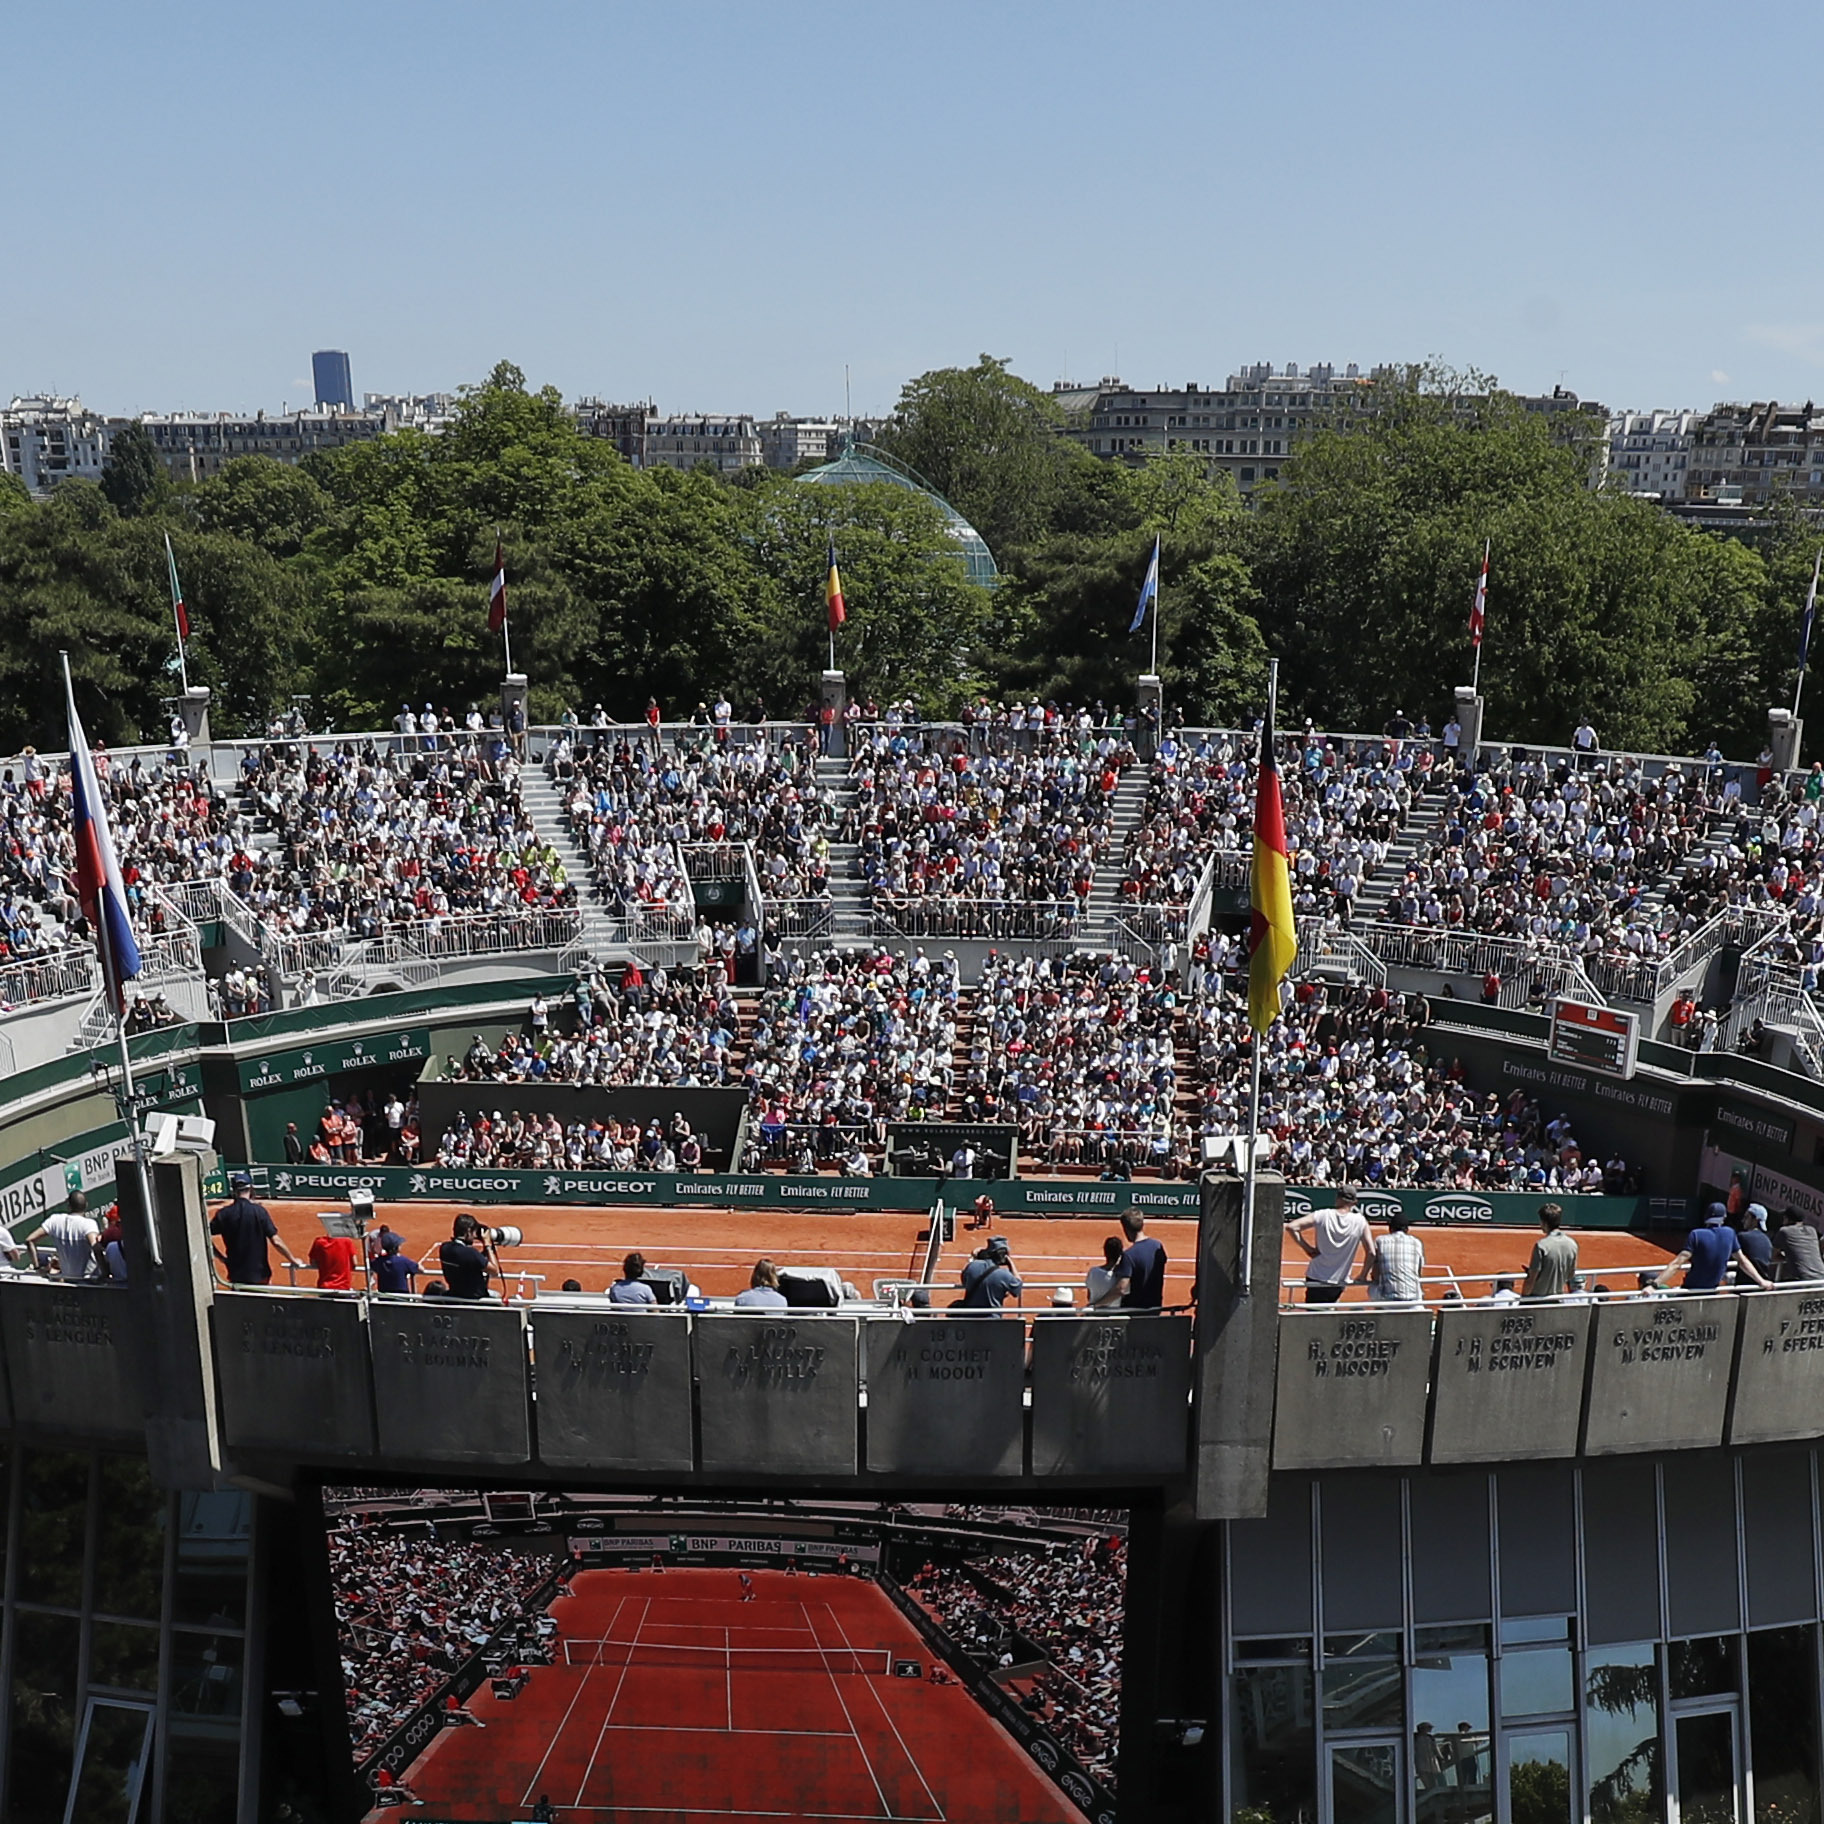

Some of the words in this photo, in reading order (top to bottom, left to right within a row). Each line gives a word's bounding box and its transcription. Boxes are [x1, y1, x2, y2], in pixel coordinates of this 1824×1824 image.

[389, 1046, 423, 1061] ROLEX
[342, 1056, 377, 1069] ROLEX
[293, 1063, 326, 1080] ROLEX
[1503, 1060, 1546, 1082] Emirates
[249, 1073, 283, 1089] ROLEX
[168, 1084, 199, 1101] ROLEX
[1595, 1082, 1636, 1105] Emirates
[133, 1095, 160, 1110] OLEX
[1717, 1107, 1754, 1132] Emirates
[84, 1153, 110, 1177] BNP
[295, 1175, 386, 1188] PEUGEOT
[429, 1178, 521, 1191] PEUGEOT
[564, 1181, 656, 1194] PEUGEOT
[676, 1183, 722, 1195] Emirates
[725, 1184, 739, 1195] FLY
[739, 1184, 764, 1197] BETTER
[780, 1185, 827, 1197] Emirates
[830, 1187, 843, 1198] FLY
[843, 1187, 869, 1199] BETTER
[1026, 1190, 1074, 1203] Emirates
[1076, 1192, 1089, 1203] FLY
[1089, 1192, 1116, 1204] BETTER
[1755, 1173, 1778, 1193] BNP
[1780, 1182, 1824, 1216] PARIBAS
[1131, 1192, 1180, 1205] Emirates
[1182, 1194, 1194, 1205] FLY
[1340, 1320, 1376, 1338] 1932
[1501, 1316, 1533, 1334] 1933
[47, 1328, 113, 1346] LENGLEN
[929, 1328, 966, 1343] 190
[1634, 1328, 1664, 1346] VON
[1667, 1324, 1719, 1345] CRAMM
[1330, 1340, 1401, 1360] COCHET
[1490, 1333, 1575, 1355] CRAWFORD
[751, 1345, 826, 1361] LACOSTE
[920, 1348, 992, 1362] COCHET
[1640, 1343, 1705, 1363] SCRIVEN
[1335, 1359, 1391, 1377] MOODY
[1488, 1352, 1556, 1372] SCRIVEN
[929, 1366, 986, 1380] MOODY
[1091, 1364, 1160, 1380] AUSSEM
[692, 1539, 718, 1549] BNP
[728, 1541, 782, 1553] PARIBAS
[405, 1713, 434, 1745] oppo
